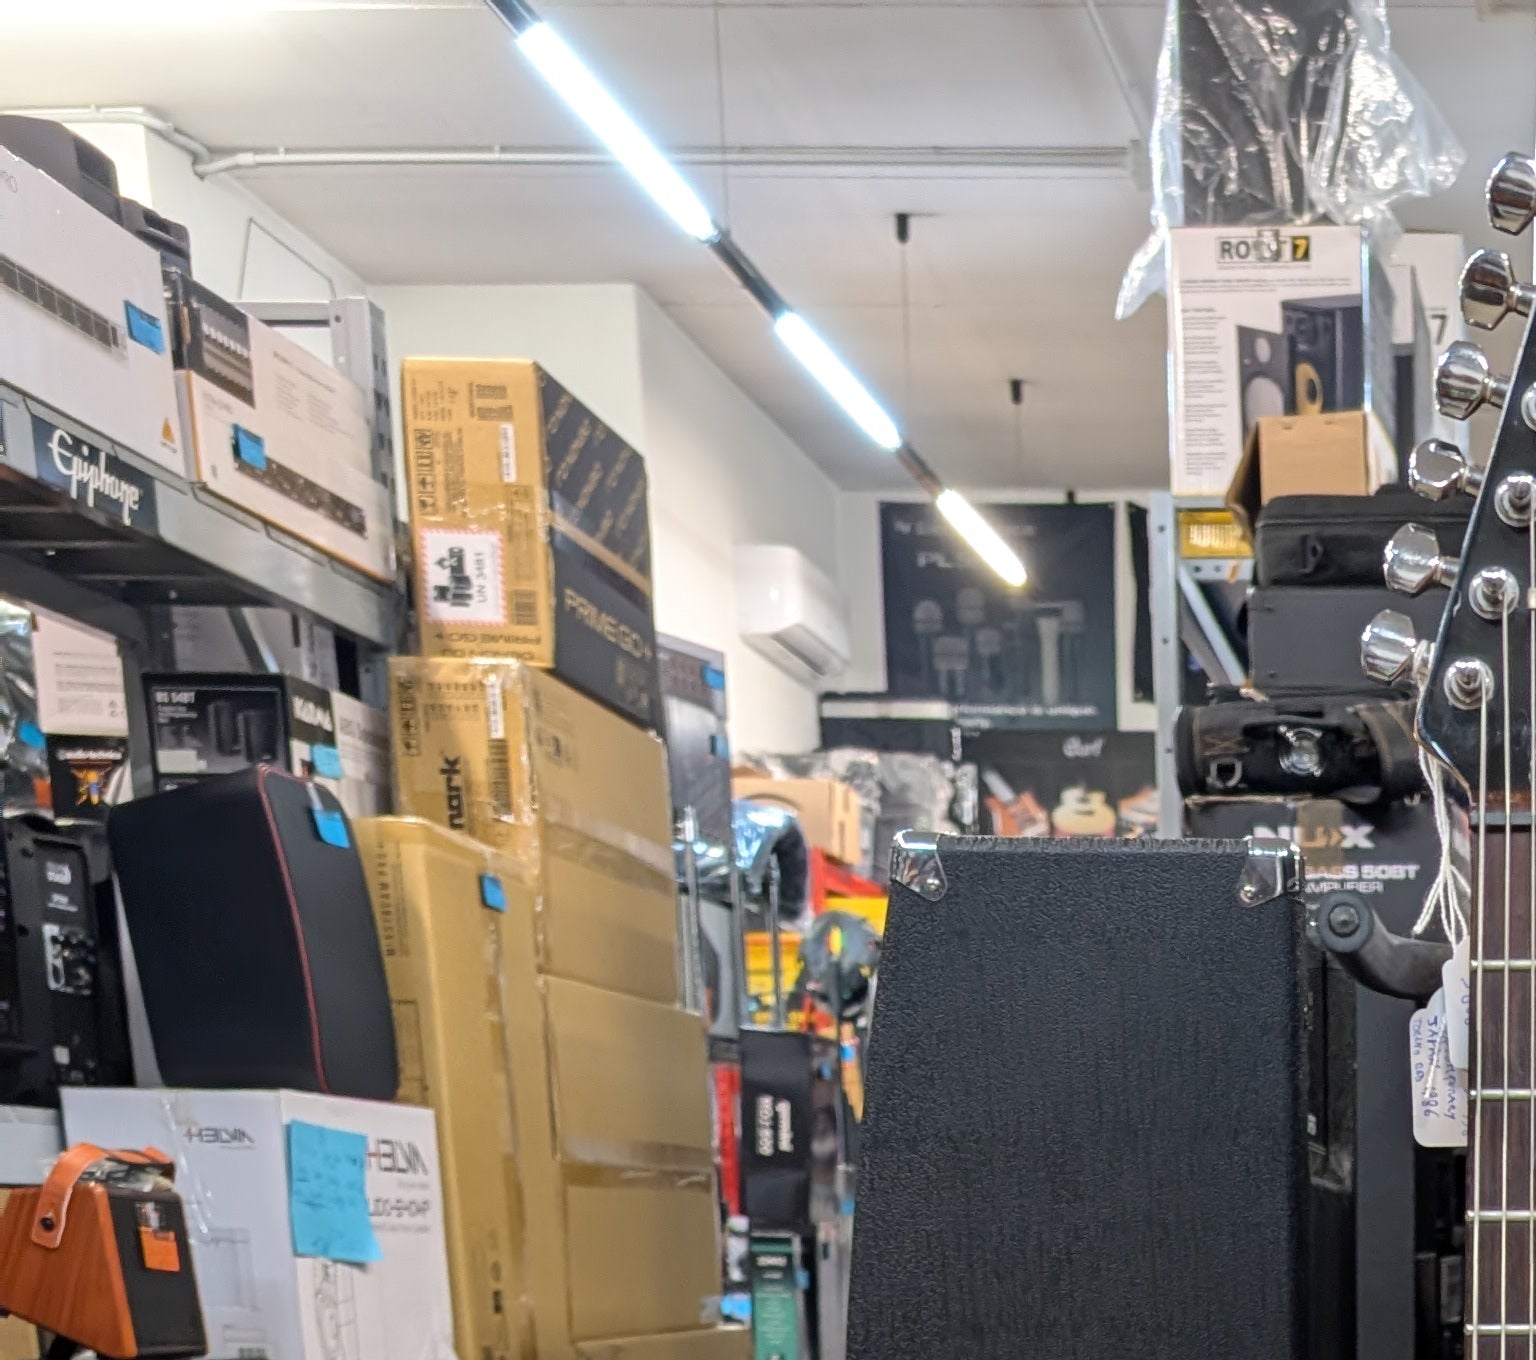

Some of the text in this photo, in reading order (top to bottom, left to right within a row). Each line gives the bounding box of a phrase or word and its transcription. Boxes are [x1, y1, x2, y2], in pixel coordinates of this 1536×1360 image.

[1294, 238, 1307, 259] 7
[48, 428, 141, 526] Epiphone
[476, 579, 489, 603] UN
